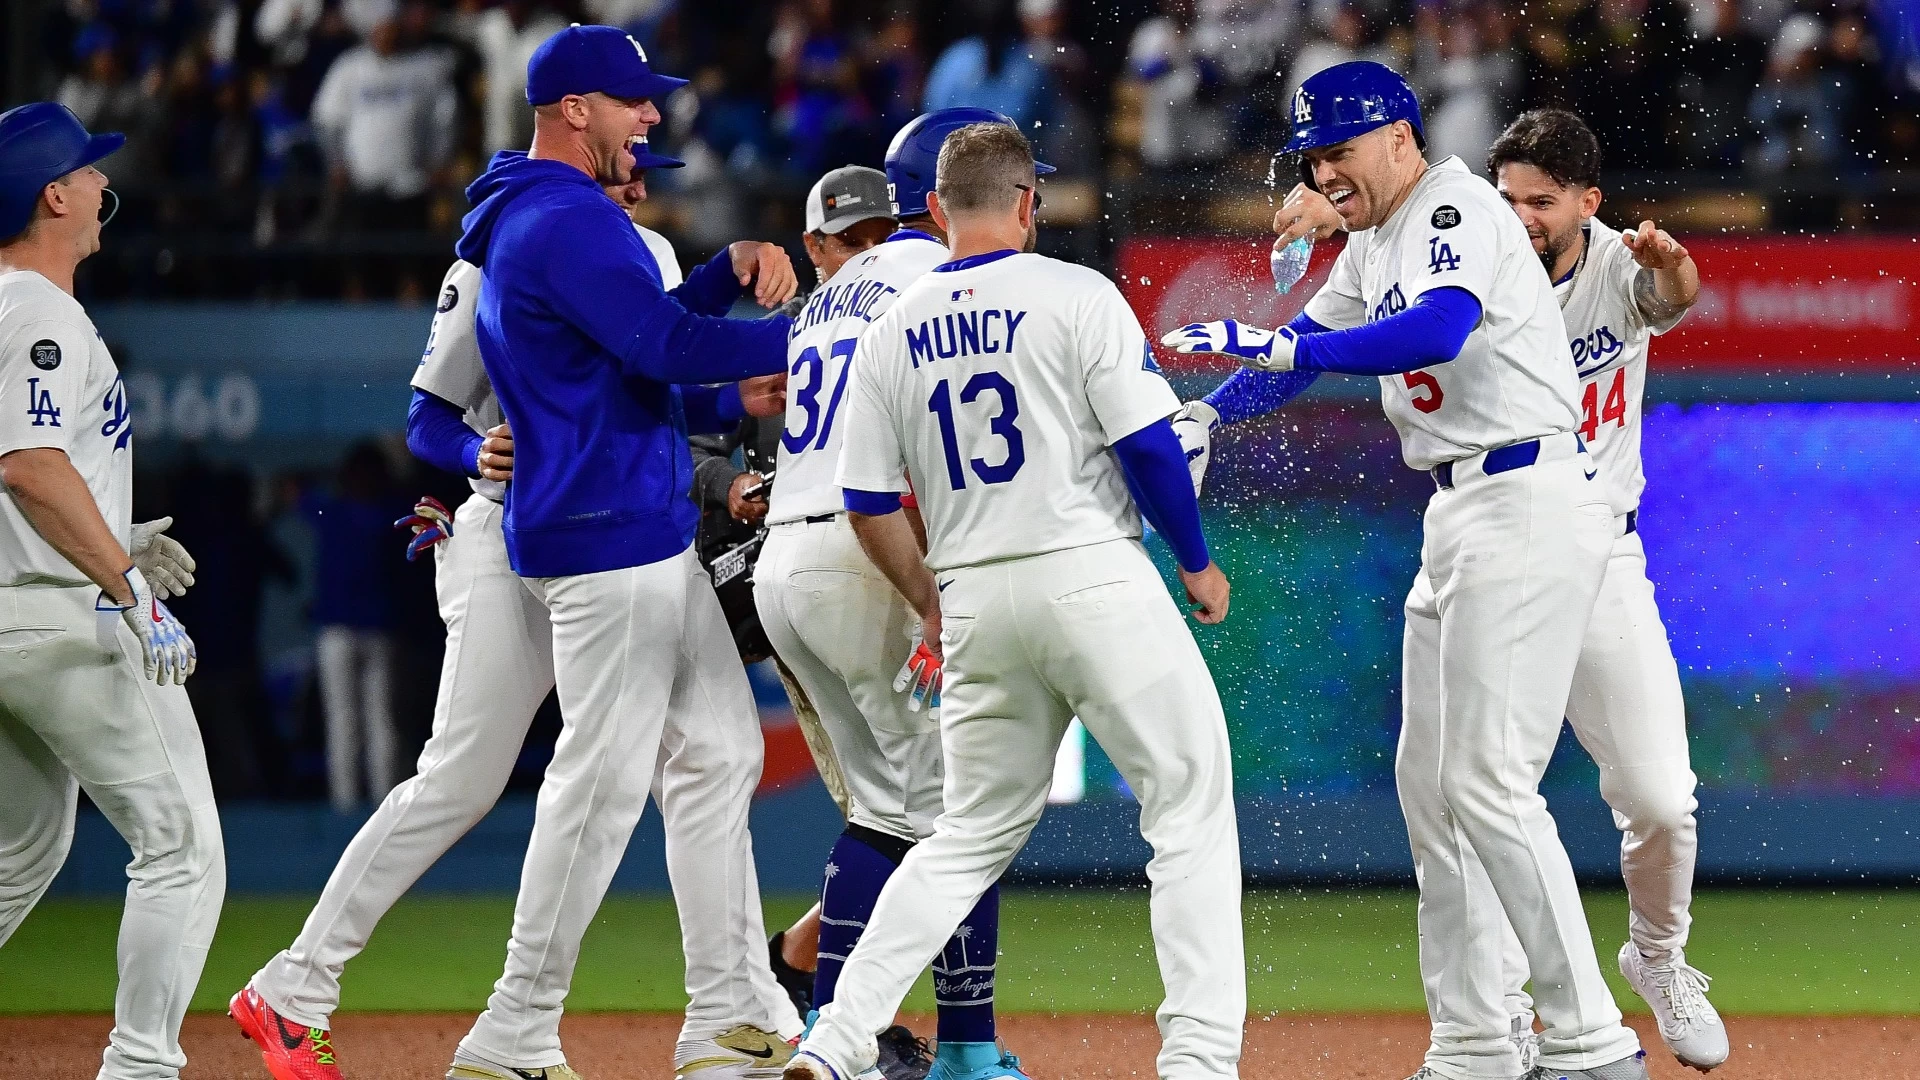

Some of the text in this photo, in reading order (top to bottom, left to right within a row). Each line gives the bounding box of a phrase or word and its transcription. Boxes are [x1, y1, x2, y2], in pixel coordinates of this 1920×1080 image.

[1294, 86, 1312, 124] LA
[1436, 213, 1456, 226] 34
[1428, 235, 1461, 276] LA
[787, 273, 902, 342] ERNÁNDE
[36, 350, 57, 365] 34
[905, 309, 1027, 369] MUNCY
[26, 377, 62, 428] LA
[780, 337, 858, 454] 37
[1402, 370, 1445, 414] 5
[1578, 366, 1627, 442] 44
[928, 371, 1025, 491] 13
[715, 554, 745, 586] SPORTS
[936, 978, 952, 995] Los
